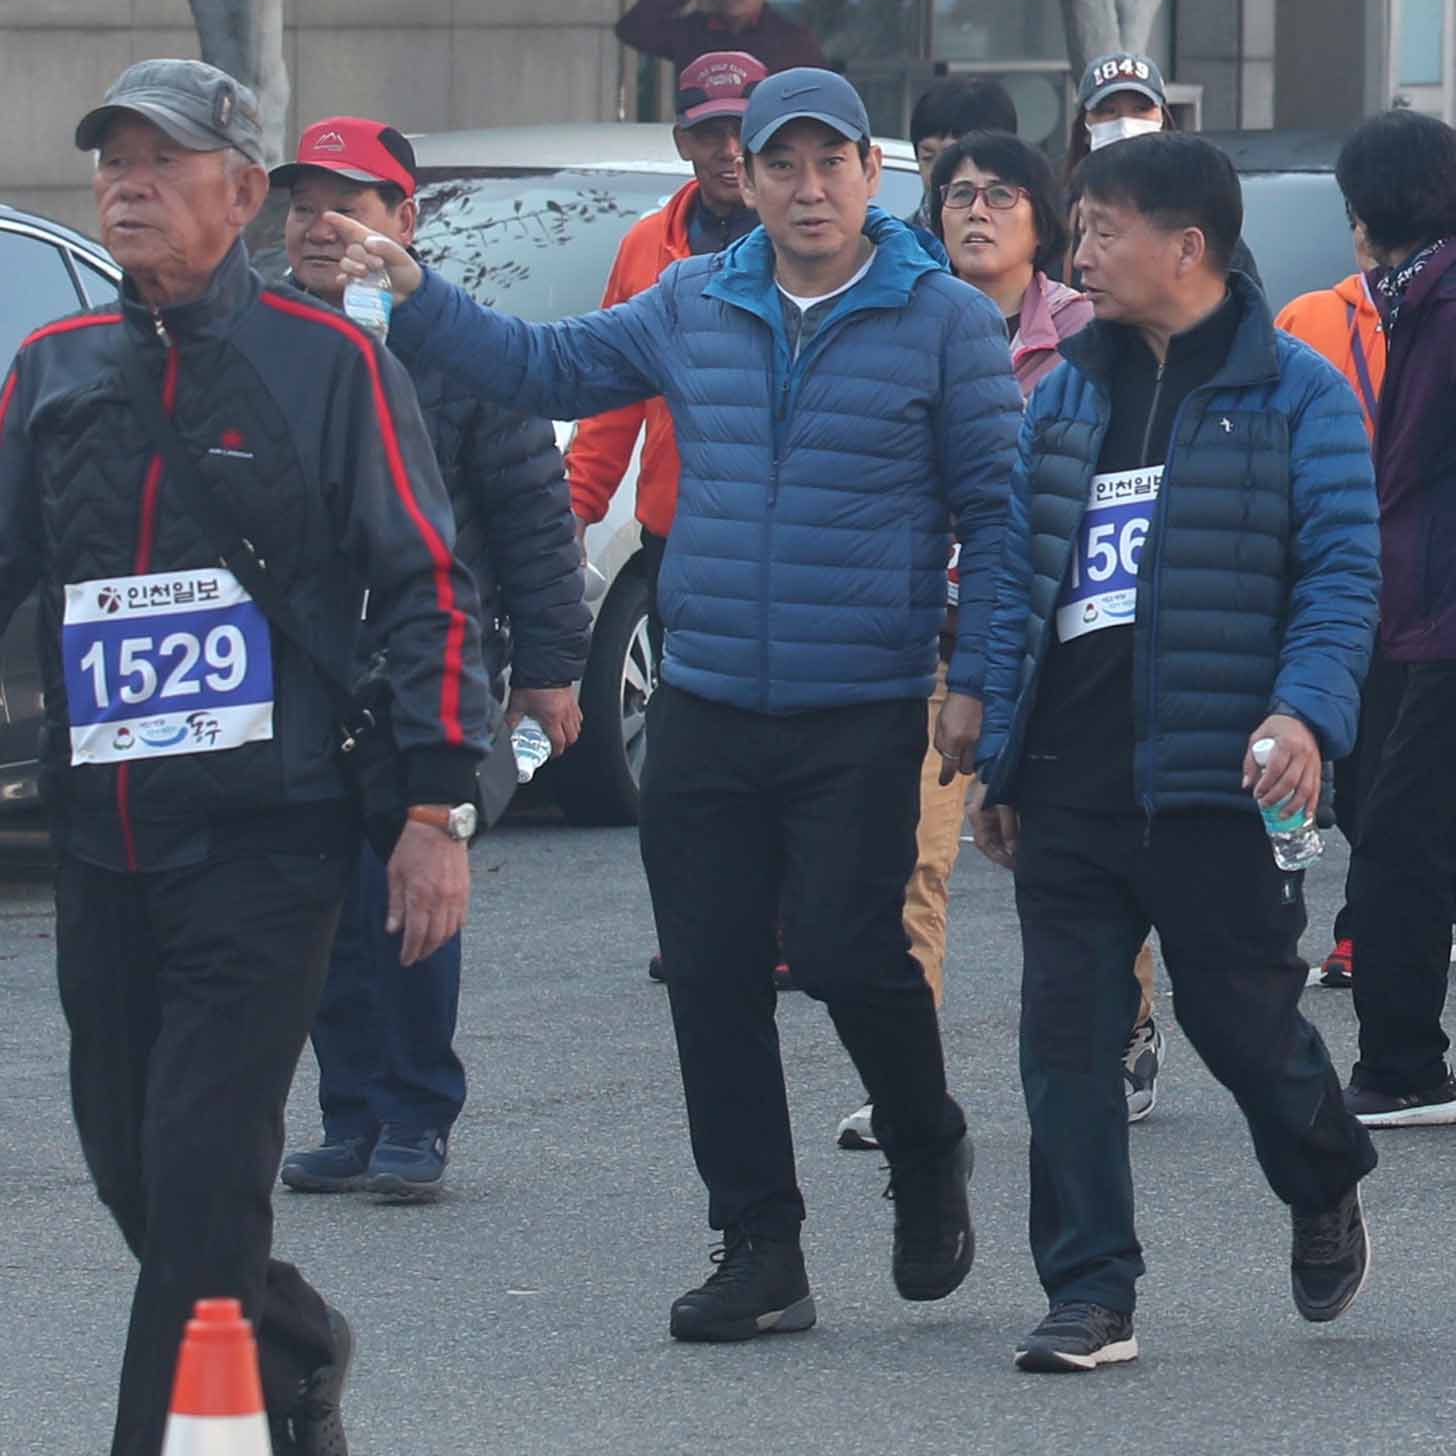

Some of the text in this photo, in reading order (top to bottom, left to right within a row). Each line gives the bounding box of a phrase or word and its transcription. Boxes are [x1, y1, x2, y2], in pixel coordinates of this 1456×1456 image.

[1094, 59, 1149, 86] 1849
[127, 578, 221, 610] 인천일보
[80, 624, 248, 709] 1529
